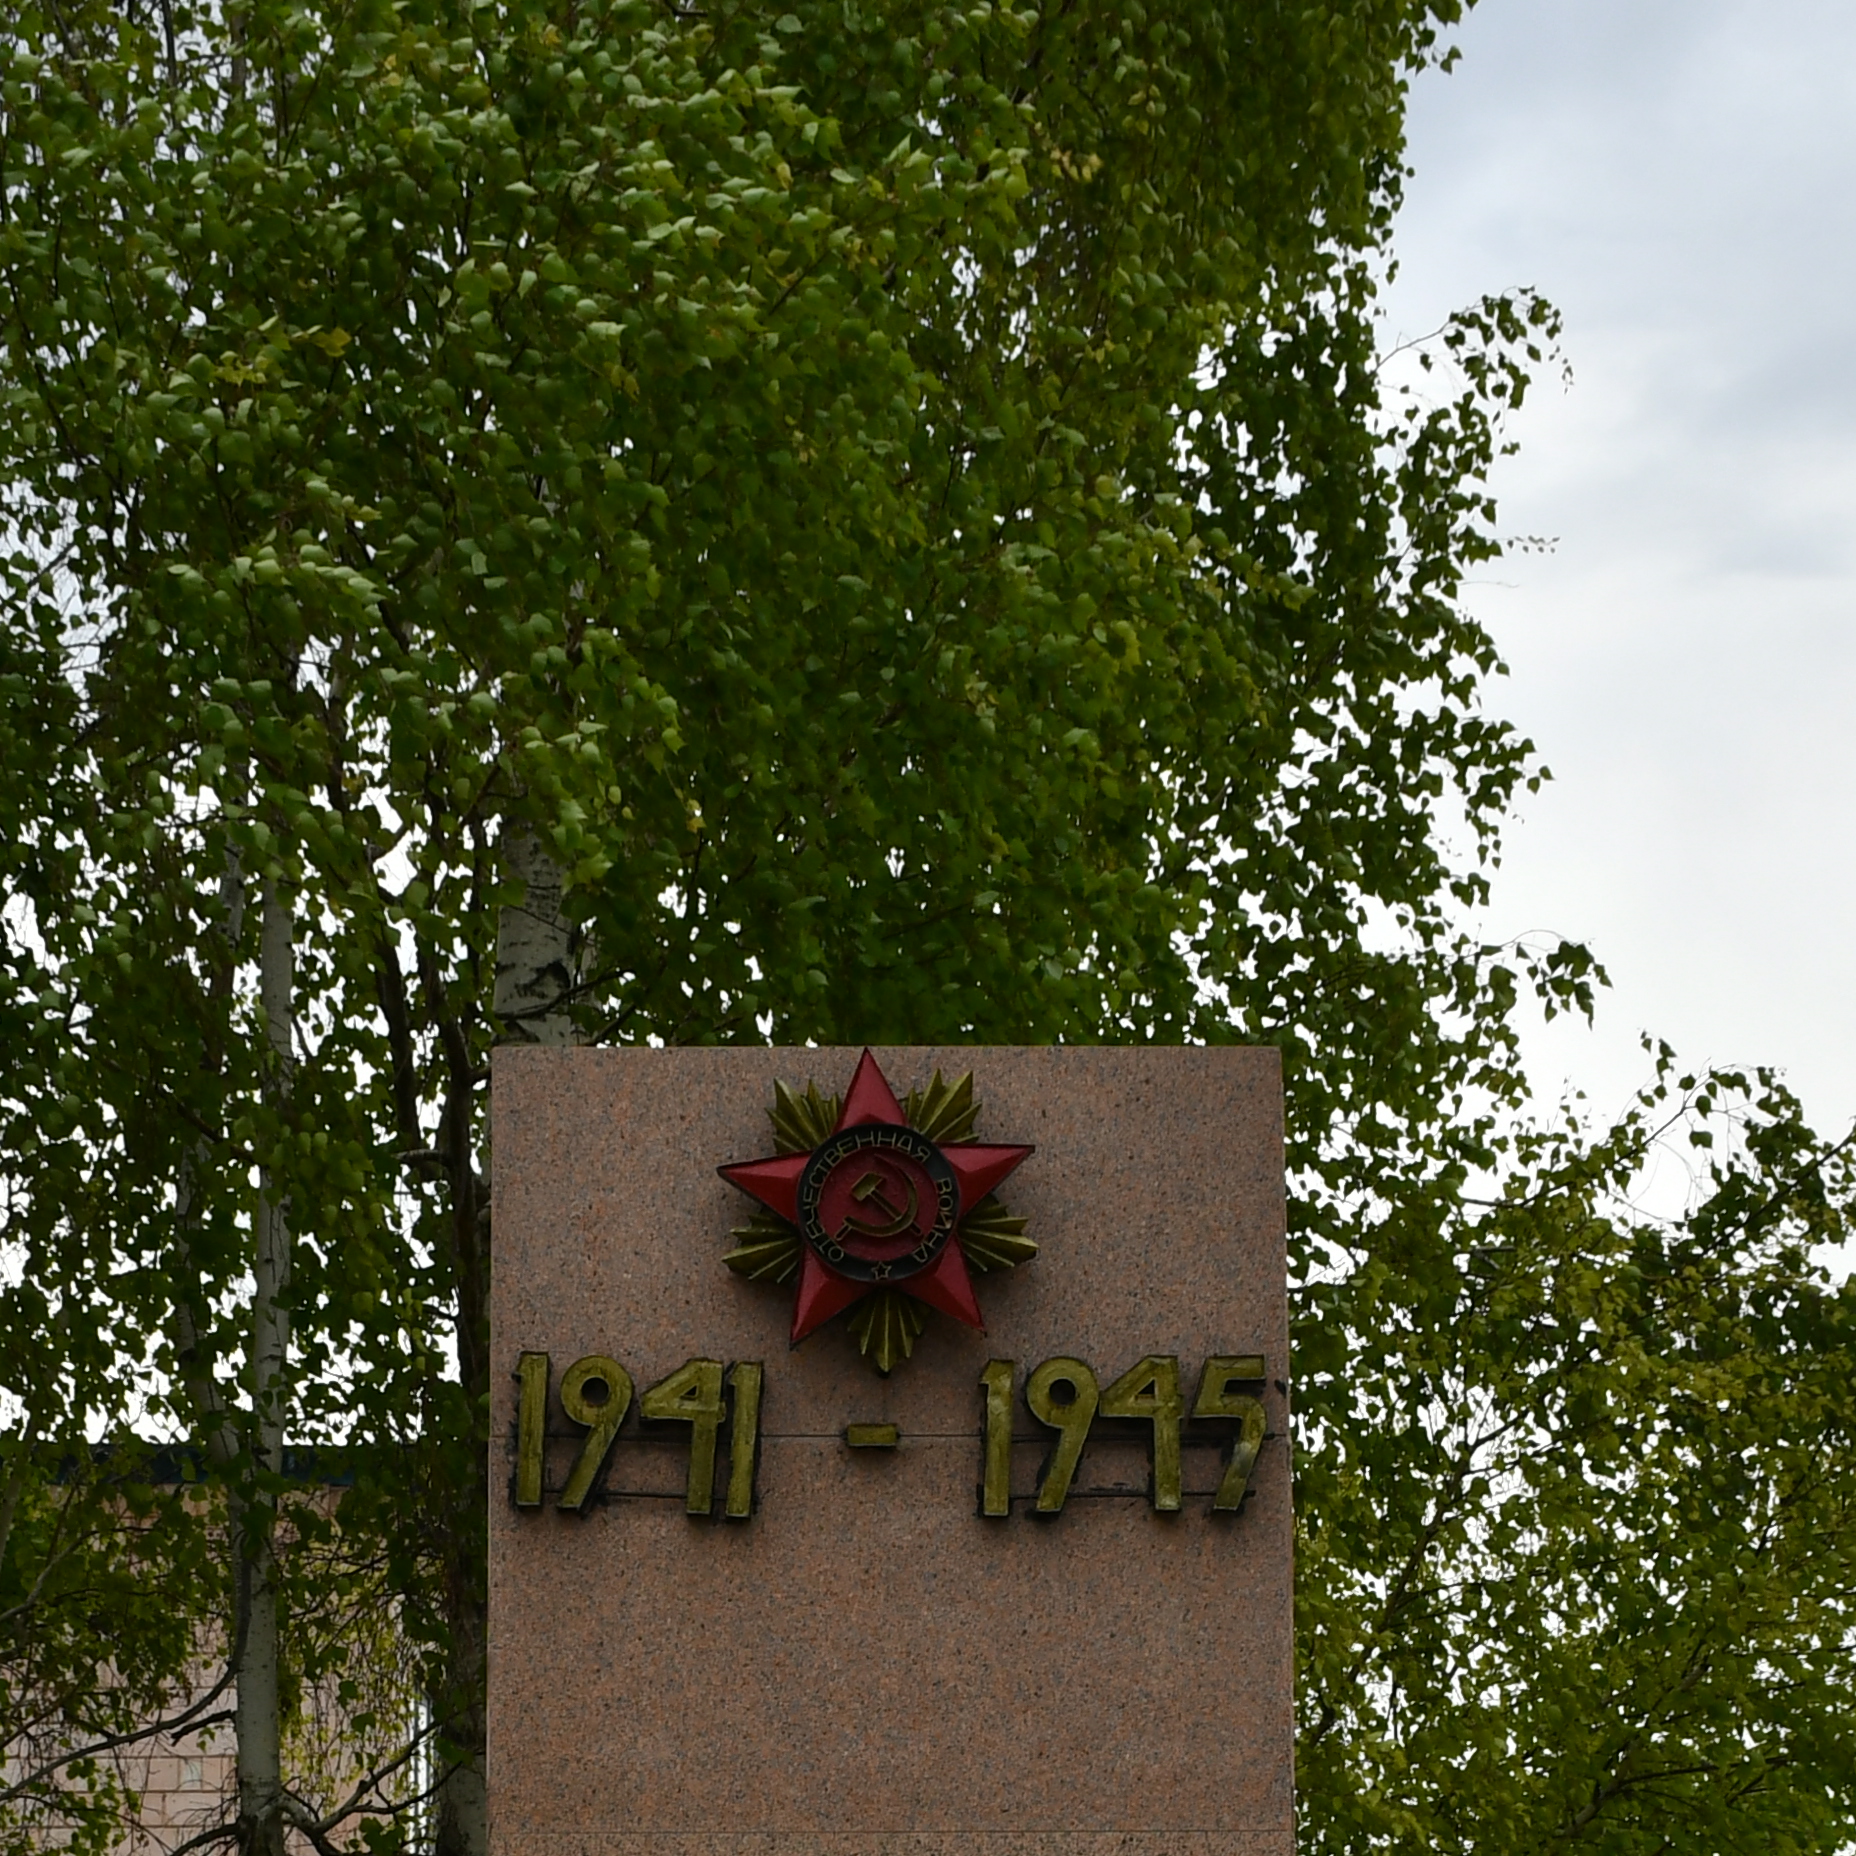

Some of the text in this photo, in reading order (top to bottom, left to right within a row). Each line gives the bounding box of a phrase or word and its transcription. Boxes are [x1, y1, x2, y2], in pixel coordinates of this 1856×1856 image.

[802, 1130, 932, 1263] ОТЕЧЕСТВЕННАЯ
[516, 1352, 764, 1519] 1941
[980, 1355, 1268, 1517] 1945
